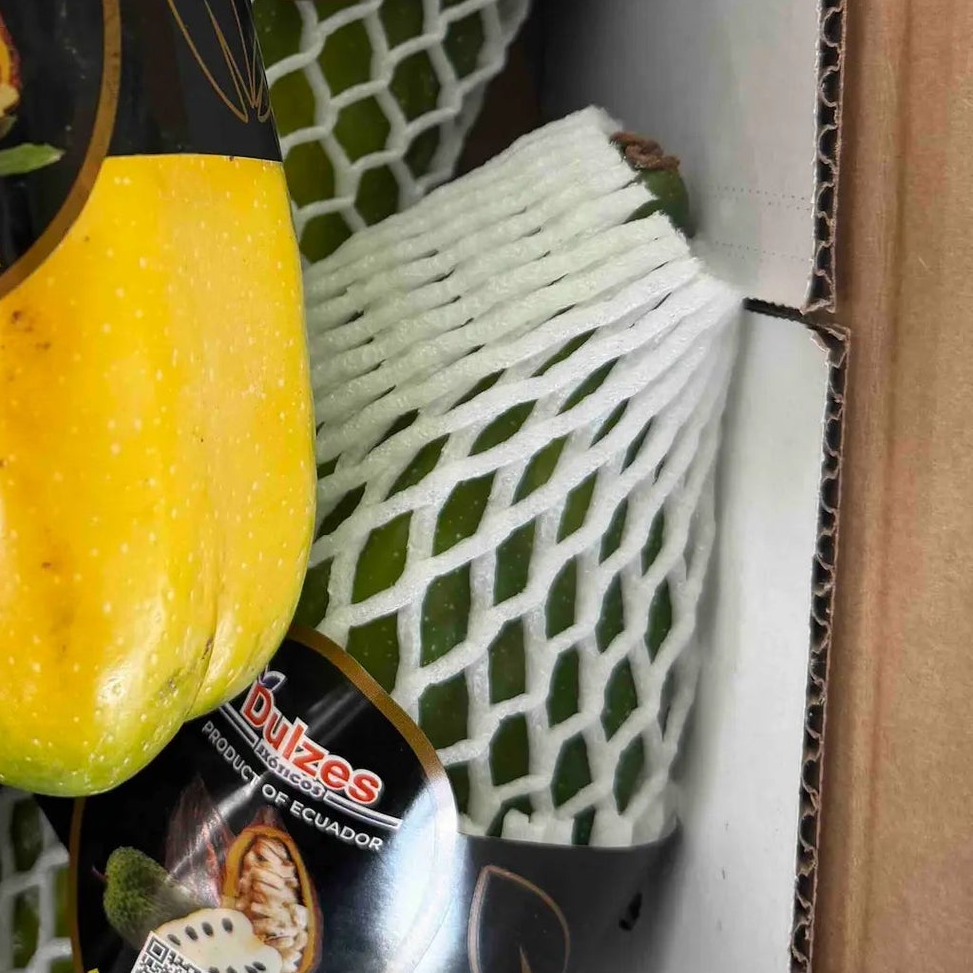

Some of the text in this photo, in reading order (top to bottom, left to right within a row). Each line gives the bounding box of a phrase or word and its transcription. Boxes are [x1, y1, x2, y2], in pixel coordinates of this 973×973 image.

[202, 721, 383, 851] PRODUCT OF ECUADOR
[241, 682, 383, 804] Dulzes
